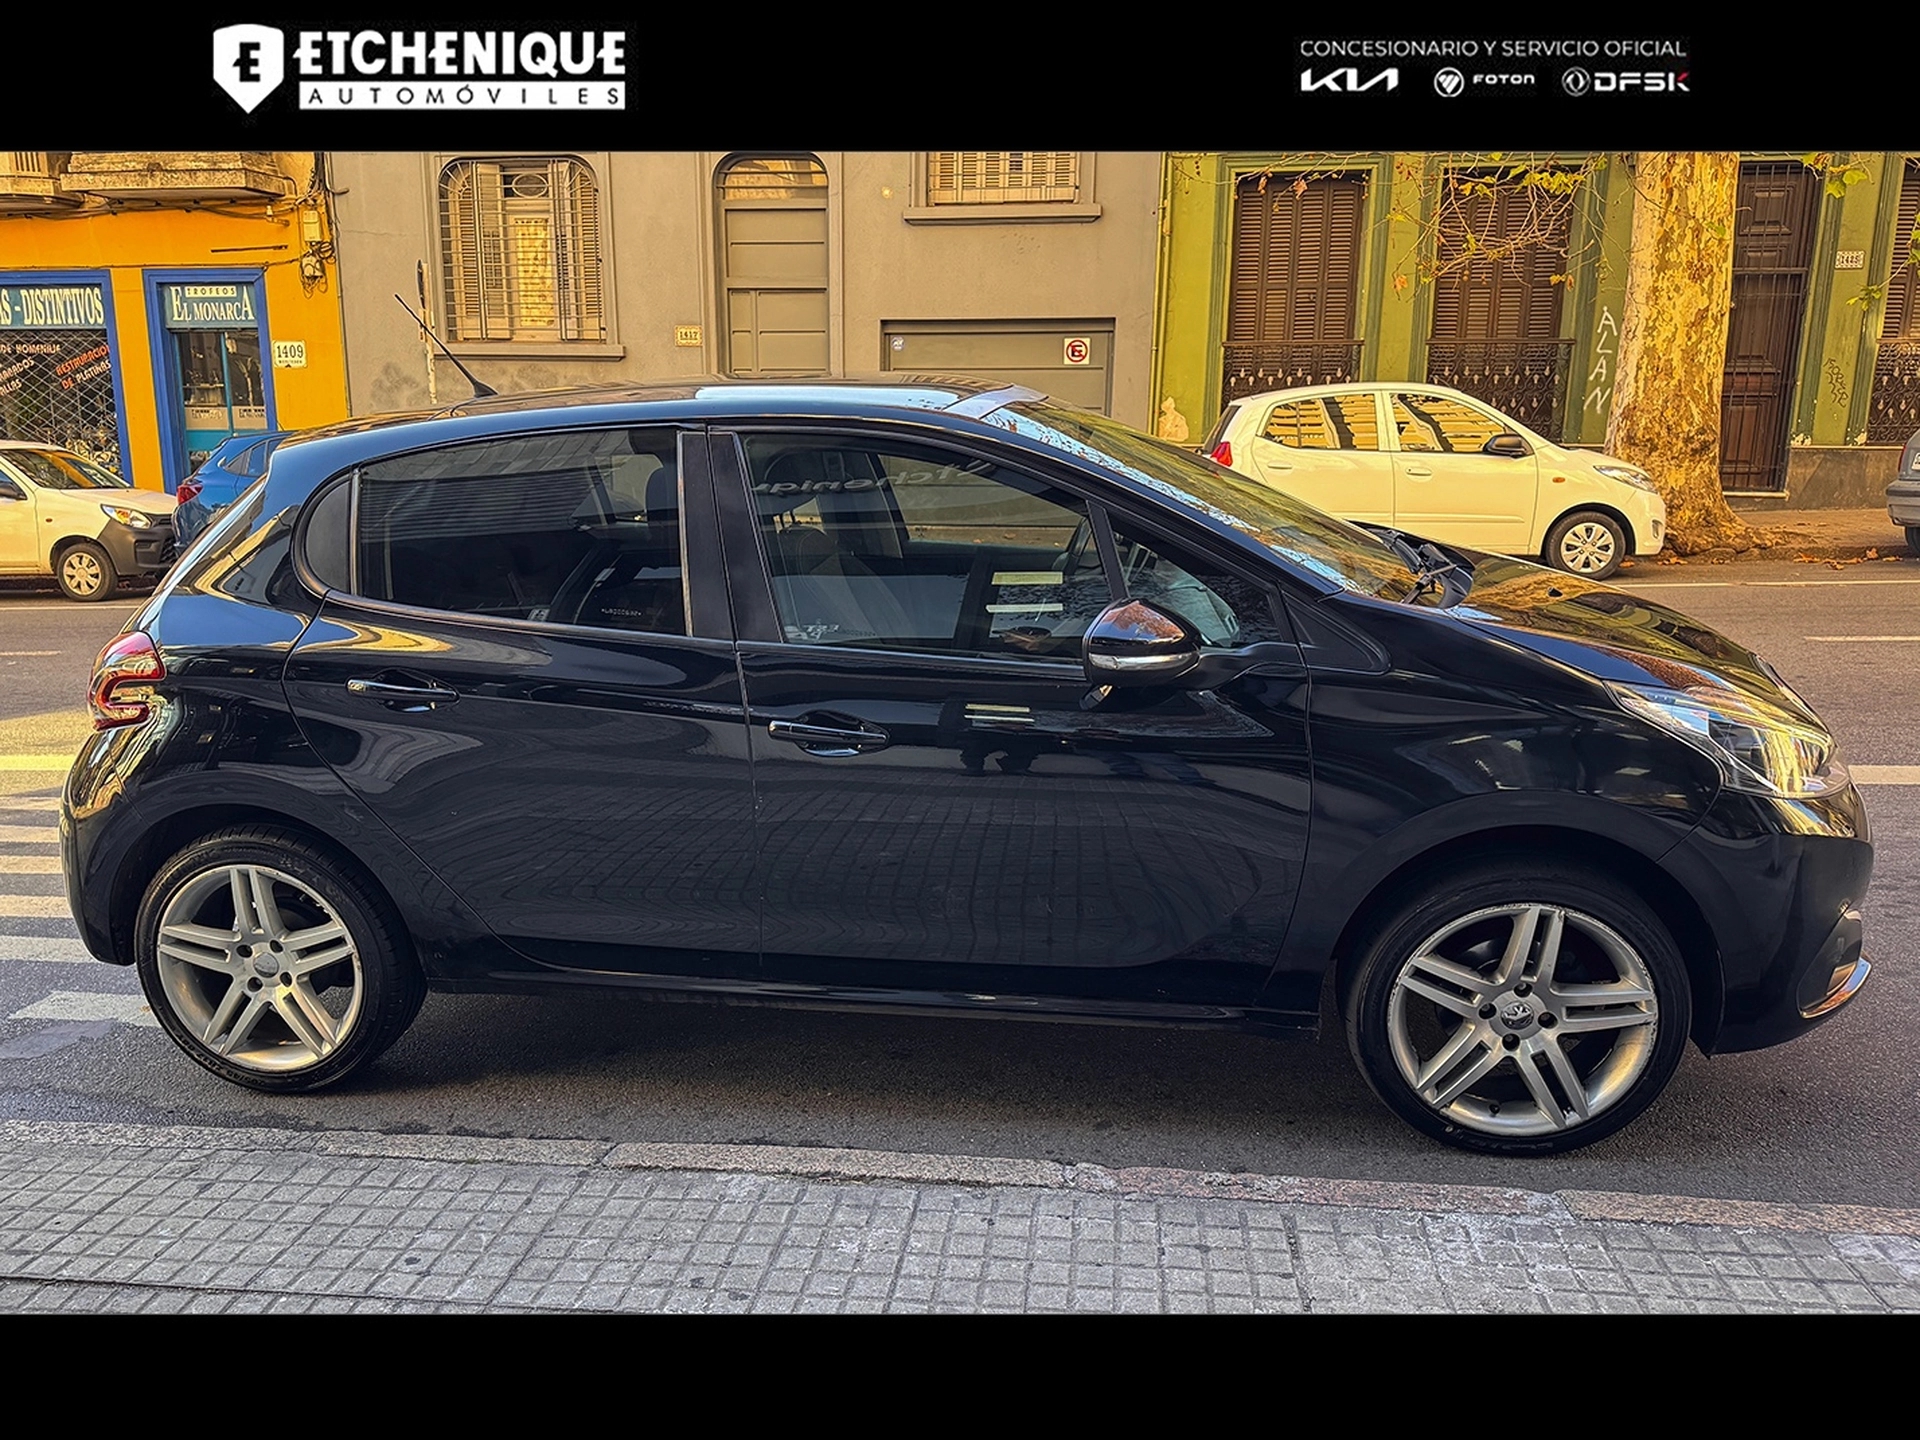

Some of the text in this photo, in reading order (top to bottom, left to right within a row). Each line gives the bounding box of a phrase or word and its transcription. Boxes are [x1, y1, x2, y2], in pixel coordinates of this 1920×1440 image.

[20, 287, 104, 325] DISTINTIVOS
[187, 287, 236, 296] TROFEOS
[192, 285, 254, 321] MONARCA
[277, 344, 304, 359] 1409
[1583, 306, 1618, 414] ALAN
[75, 359, 112, 384] PLATINAS
